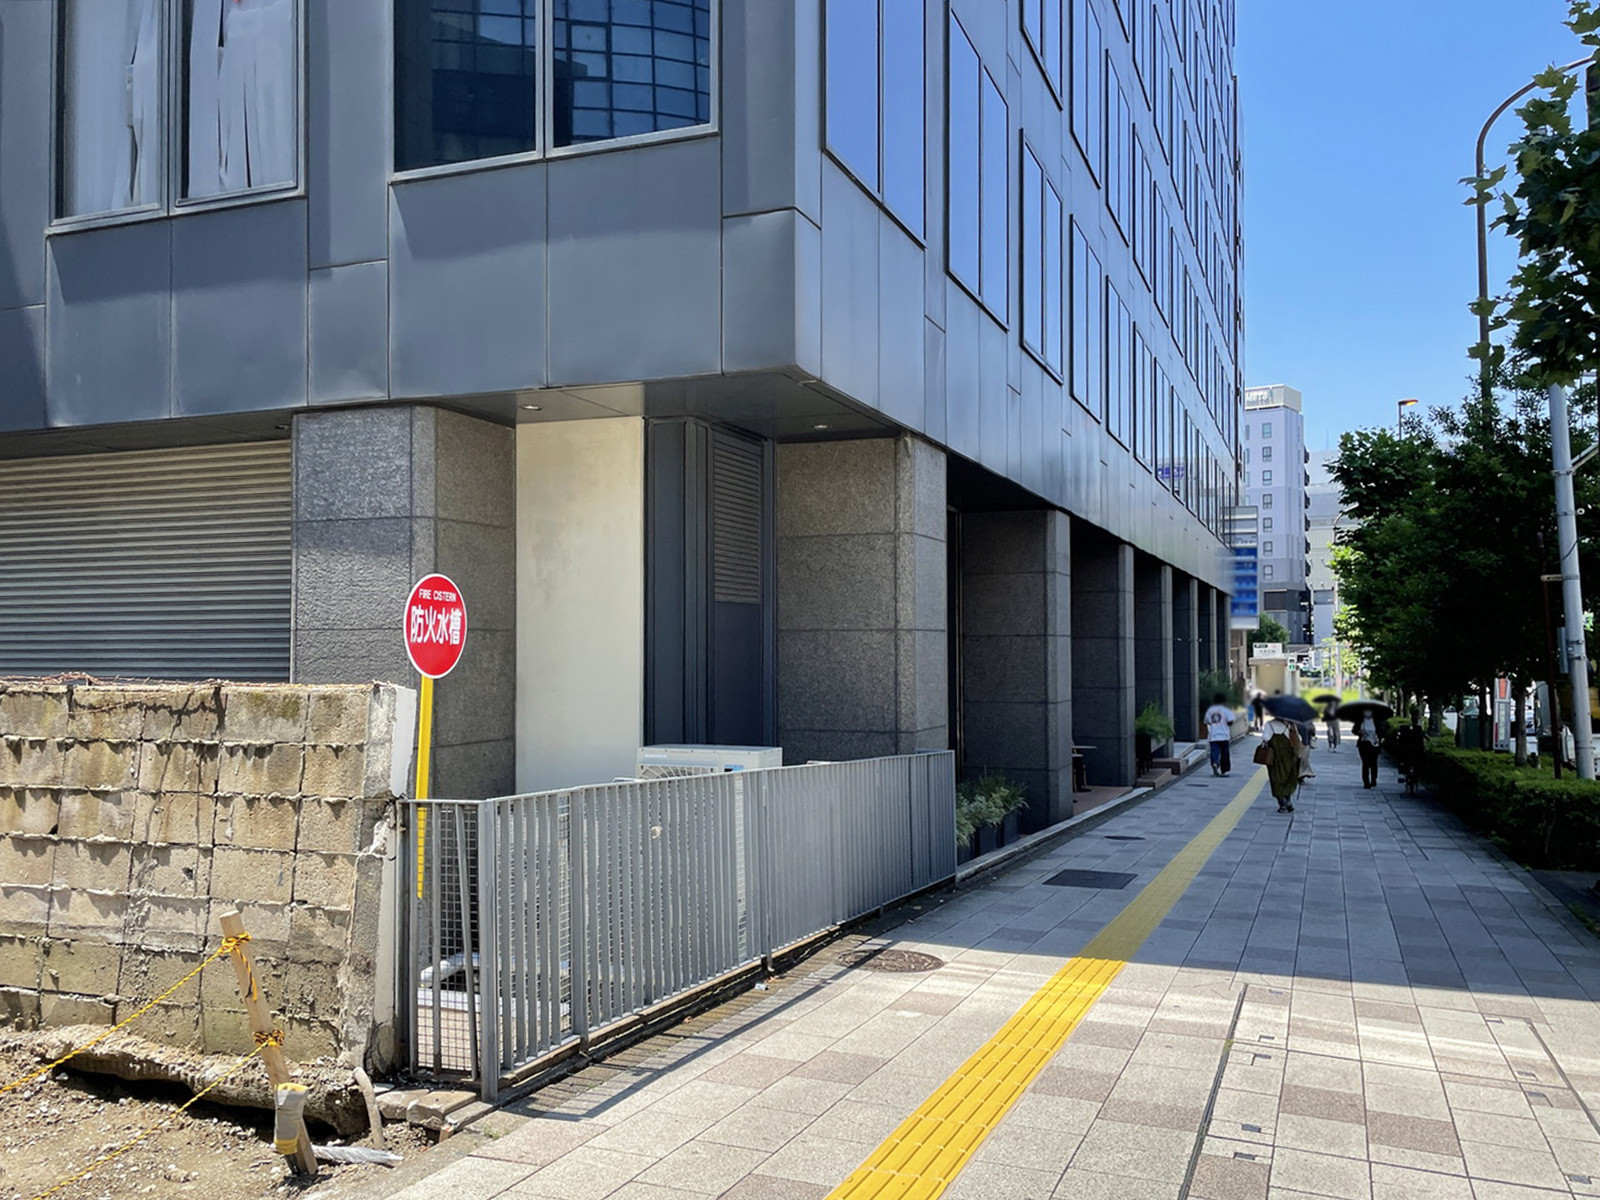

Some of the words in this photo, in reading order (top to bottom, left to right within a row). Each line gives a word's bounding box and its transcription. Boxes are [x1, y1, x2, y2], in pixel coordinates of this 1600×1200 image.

[418, 588, 432, 600] FIRE
[433, 590, 457, 602] CISTERN
[410, 604, 462, 645] 防火水槽
